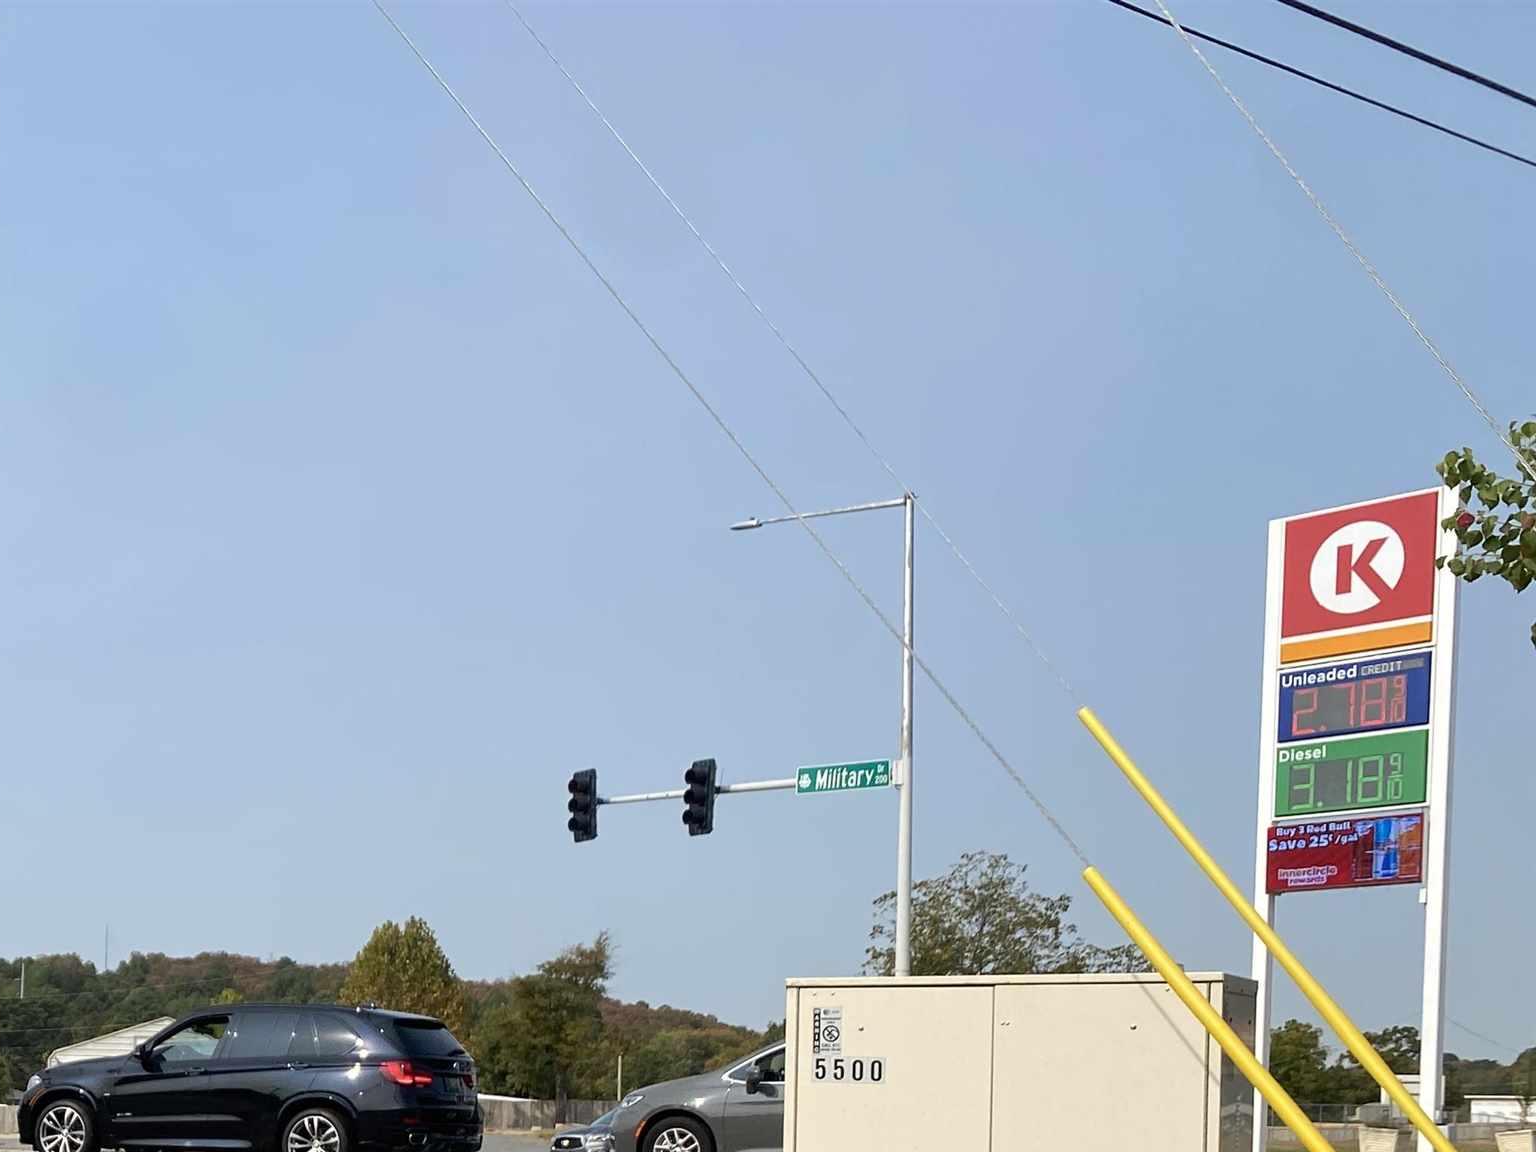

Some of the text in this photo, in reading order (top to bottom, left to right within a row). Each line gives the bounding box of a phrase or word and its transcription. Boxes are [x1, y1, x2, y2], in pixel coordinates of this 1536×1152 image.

[1281, 660, 1403, 688] Unleaded CREDIT
[1278, 744, 1327, 763] Diesel
[815, 764, 885, 790] Military Dr
[1276, 821, 1351, 837] Buy 3 Red Bull
[1268, 838, 1306, 851] Save
[814, 1058, 883, 1082] 5500
